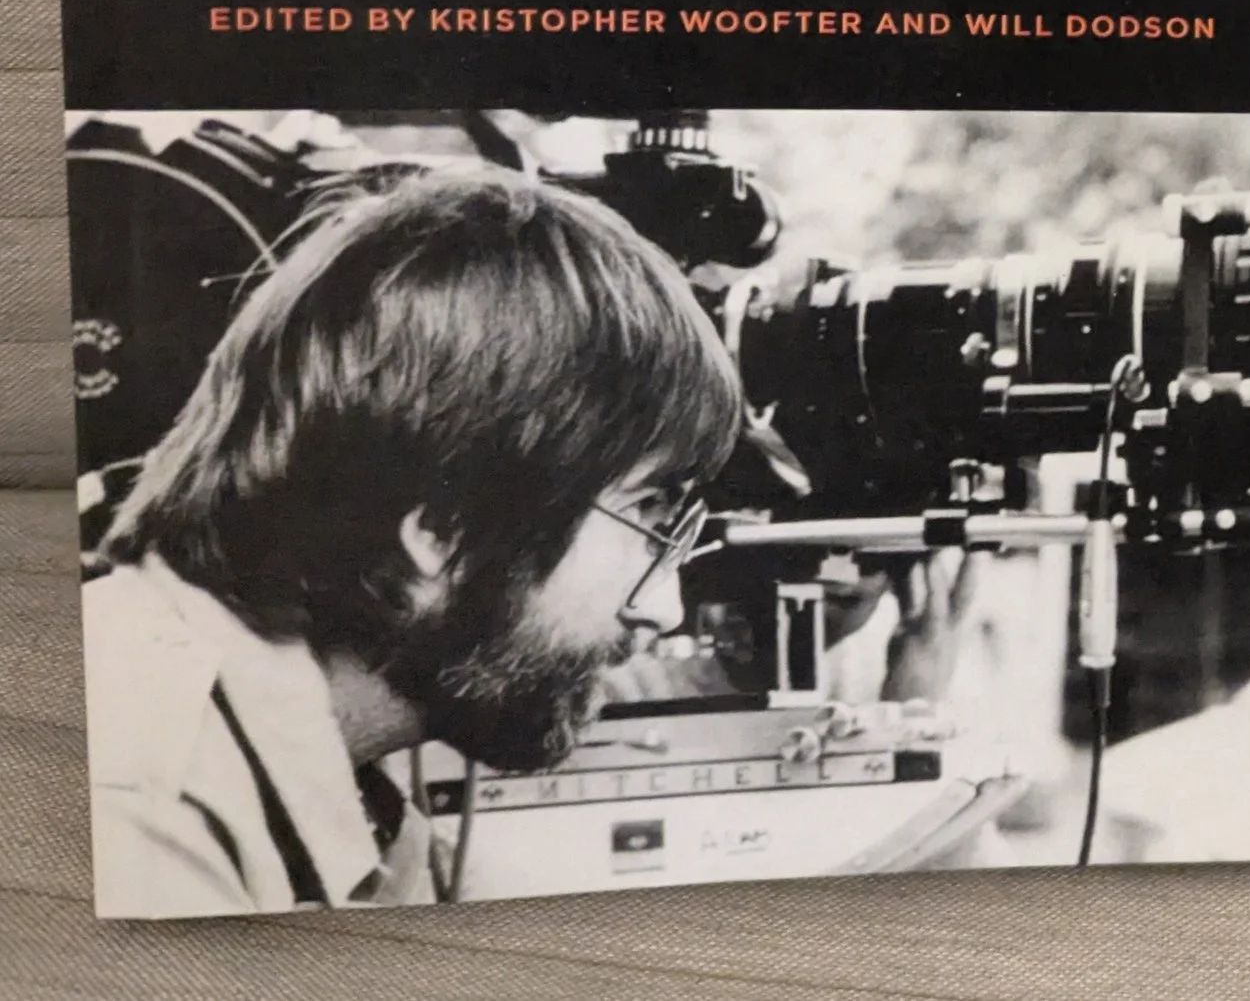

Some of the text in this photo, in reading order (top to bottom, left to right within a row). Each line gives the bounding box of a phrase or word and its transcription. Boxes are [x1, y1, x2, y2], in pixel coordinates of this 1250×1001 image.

[210, 7, 1216, 40] EDITED BY KRISTOPHER WOOFTER AND WILL DODSON
[537, 760, 830, 800] MITCHELL
